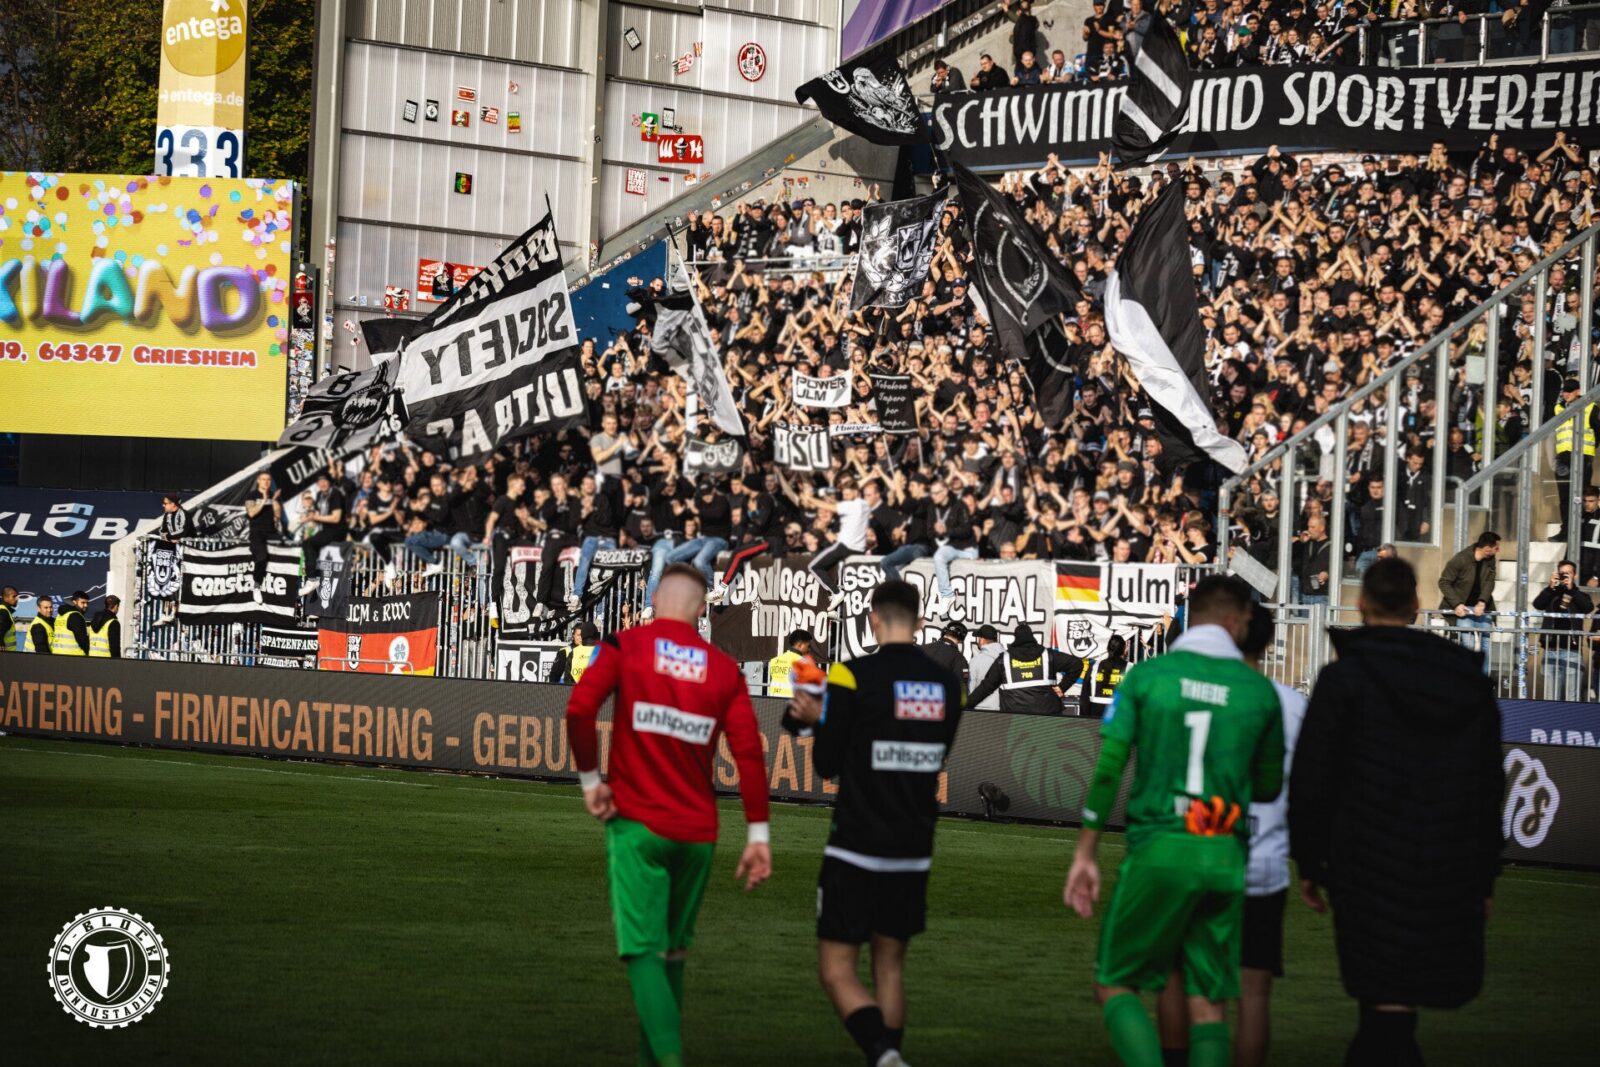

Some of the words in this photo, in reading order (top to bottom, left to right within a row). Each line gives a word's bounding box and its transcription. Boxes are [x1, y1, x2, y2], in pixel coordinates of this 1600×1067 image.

[165, 15, 243, 45] entega
[170, 88, 244, 107] entega.de
[38, 342, 122, 363] 64347
[133, 346, 257, 367] GRIESHEIM
[796, 376, 847, 390] POWER
[34, 557, 86, 567] LILIEN
[191, 572, 287, 597] constate
[1117, 569, 1171, 605] ulm
[261, 635, 319, 651] SPATZENFANS
[897, 700, 945, 719] MOLY
[154, 690, 433, 761] FIRMENCATERING
[635, 707, 711, 738] uhlsport
[1184, 710, 1212, 795] 1
